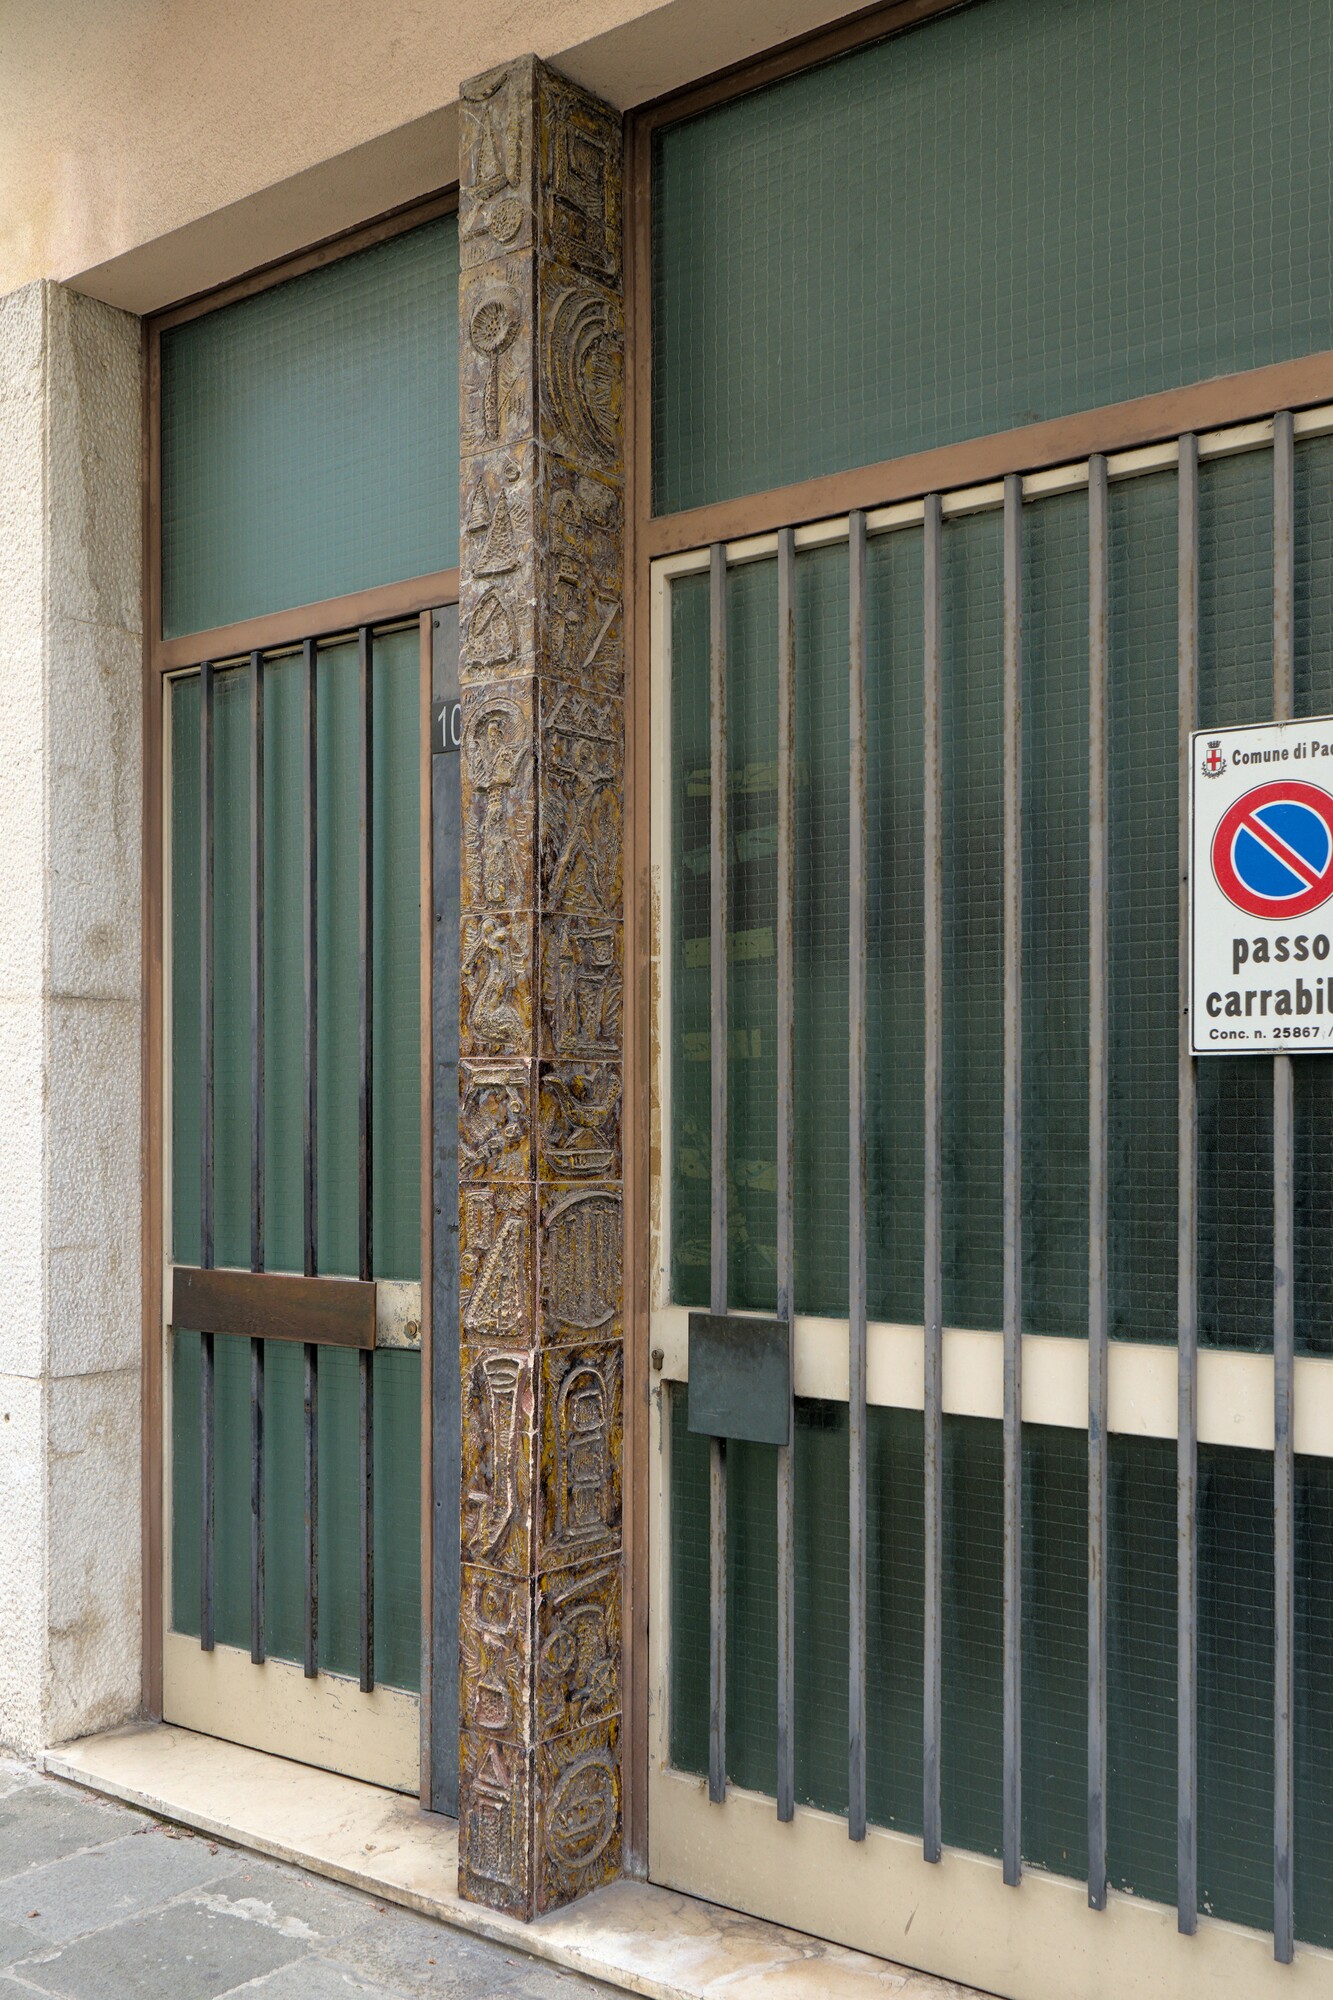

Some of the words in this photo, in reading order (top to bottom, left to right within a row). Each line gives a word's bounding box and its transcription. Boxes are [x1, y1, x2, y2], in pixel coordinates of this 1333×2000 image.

[438, 703, 461, 747] 10
[1232, 749, 1289, 766] Comune
[1293, 742, 1307, 759] di
[1232, 934, 1330, 975] passo
[1209, 1028, 1249, 1040] Conc.
[1254, 1030, 1266, 1039] n.
[1273, 1027, 1320, 1038] 25867
